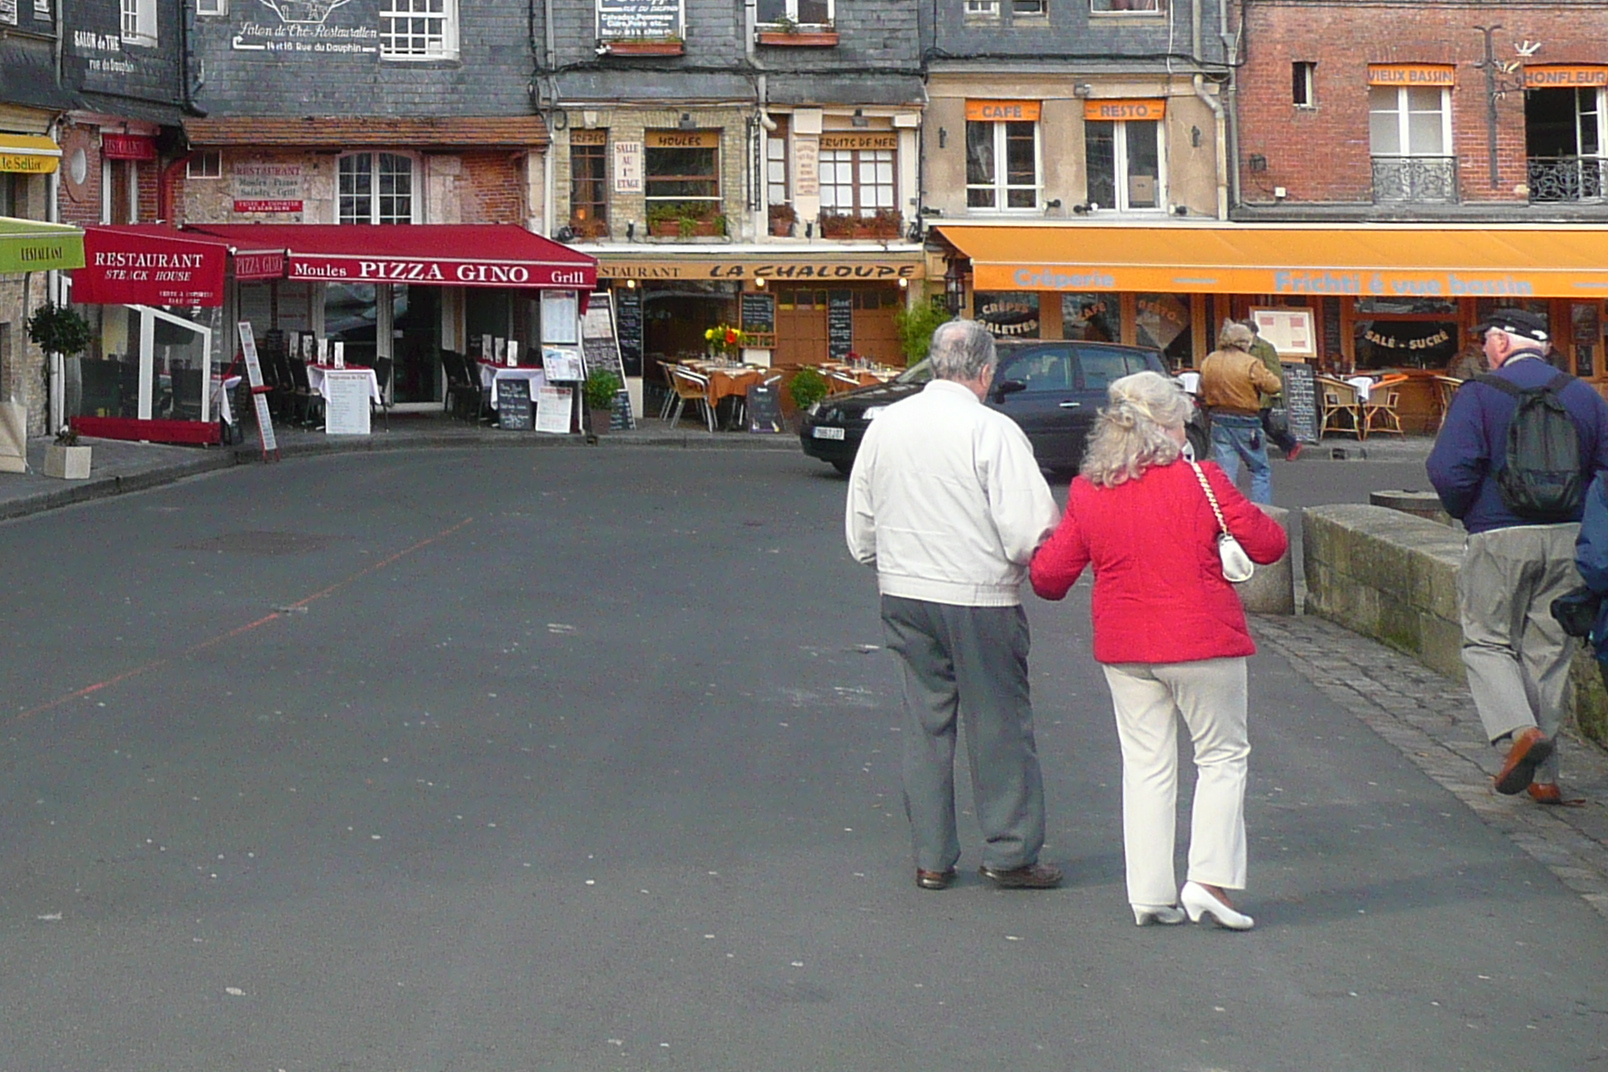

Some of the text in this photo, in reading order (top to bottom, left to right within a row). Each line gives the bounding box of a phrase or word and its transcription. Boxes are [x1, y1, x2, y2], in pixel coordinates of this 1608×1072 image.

[74, 30, 97, 49] SALON
[97, 35, 106, 50] de
[296, 42, 312, 51] Rue
[314, 42, 325, 52] du
[326, 42, 362, 53] Dauphin
[89, 59, 101, 71] rue
[1368, 69, 1453, 83] VIEUX BASSIN
[1524, 70, 1607, 84] HONFLEUR
[1100, 104, 1148, 118] RESTO
[658, 135, 702, 146] MOULES
[820, 137, 896, 148] FRUITS DE MER
[616, 143, 639, 154] SALLE
[622, 156, 633, 166] AU
[236, 166, 302, 176] RESTAURANT
[616, 178, 640, 189] ETAGE
[94, 251, 204, 268] RESTAURANT
[235, 255, 284, 275] PIZZA GINO
[154, 270, 192, 282] HOUSE
[294, 261, 585, 285] Moules PIZZA GINO Grill
[709, 265, 746, 278] LA
[752, 264, 915, 279] CHALOUPE
[1013, 268, 1116, 289] Crêperie
[1273, 271, 1361, 294] Frichti
[1392, 280, 1440, 295] vue
[1448, 273, 1533, 296] bassin
[981, 298, 1030, 315] CRÊPES
[1364, 327, 1450, 350] SALÉ SUCRÉ
